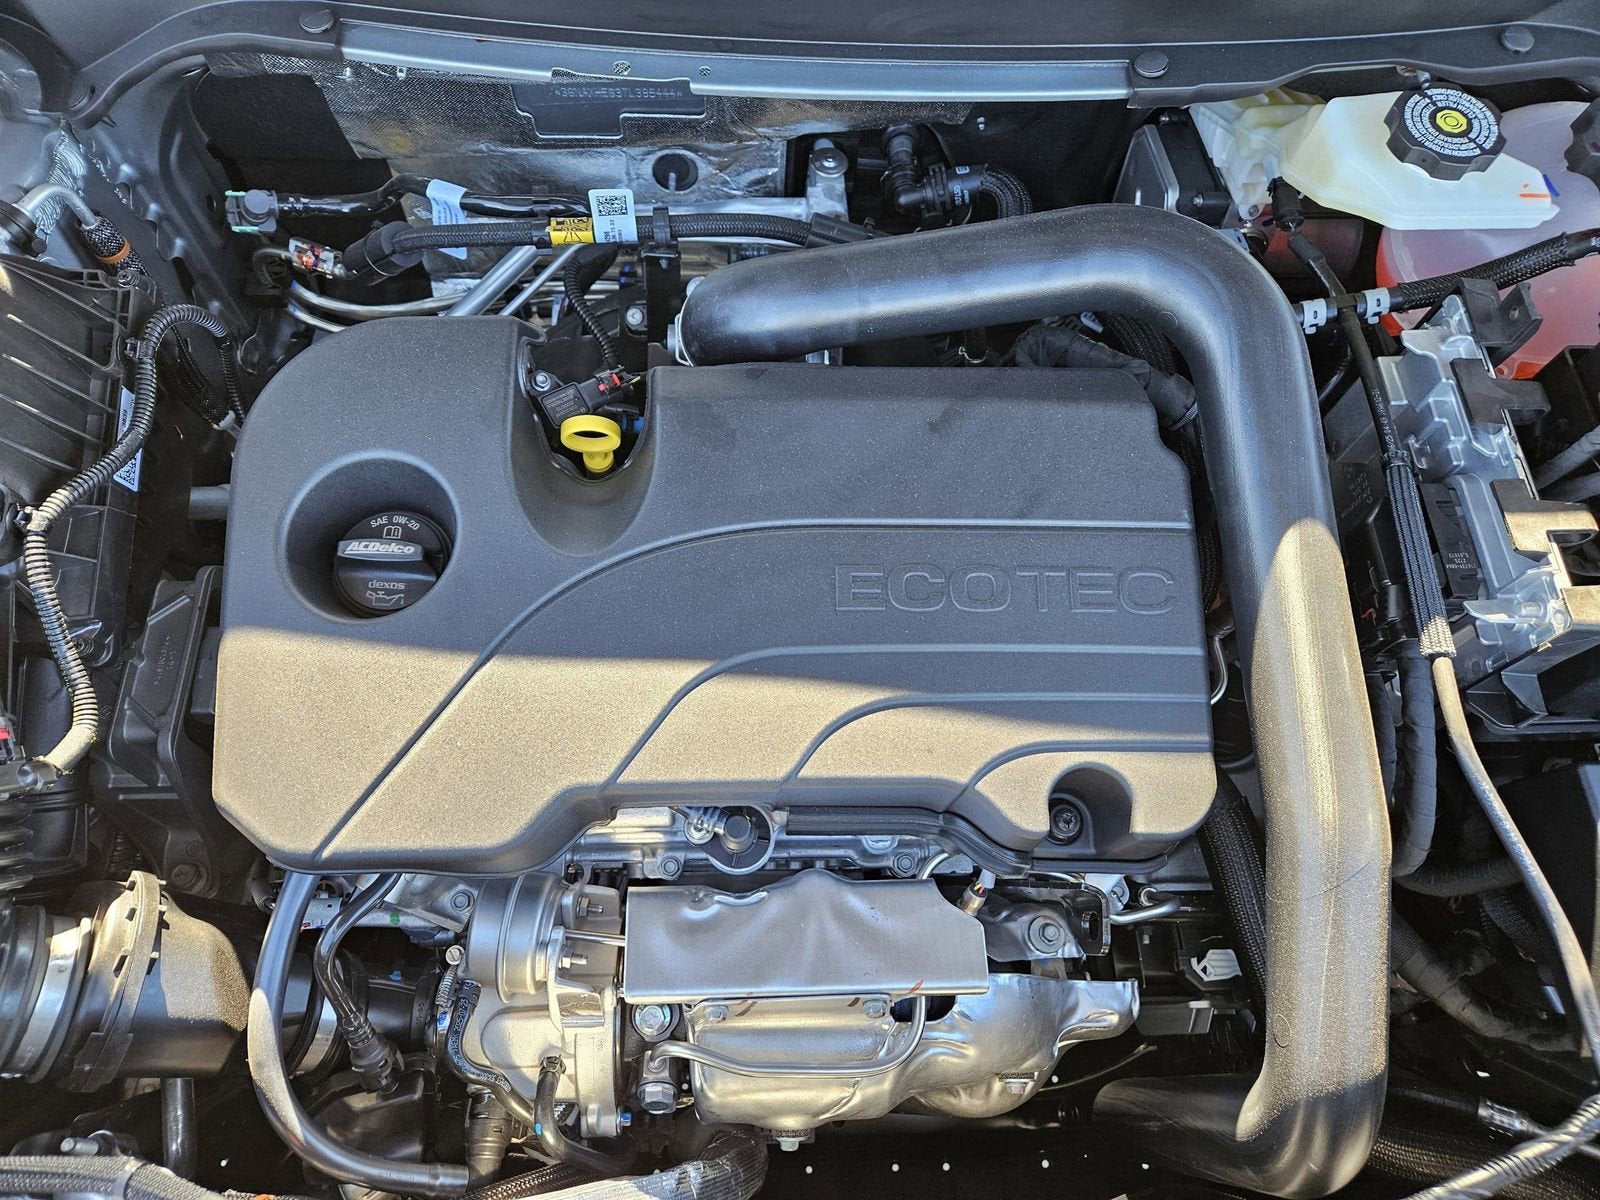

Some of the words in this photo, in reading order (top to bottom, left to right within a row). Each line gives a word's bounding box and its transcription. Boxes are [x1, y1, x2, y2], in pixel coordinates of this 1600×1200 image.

[370, 515, 388, 528] SAE
[392, 515, 420, 531] 0W-20
[346, 541, 415, 554] ACDelco
[368, 580, 405, 590] dexos
[835, 563, 1175, 615] ECOTEC
